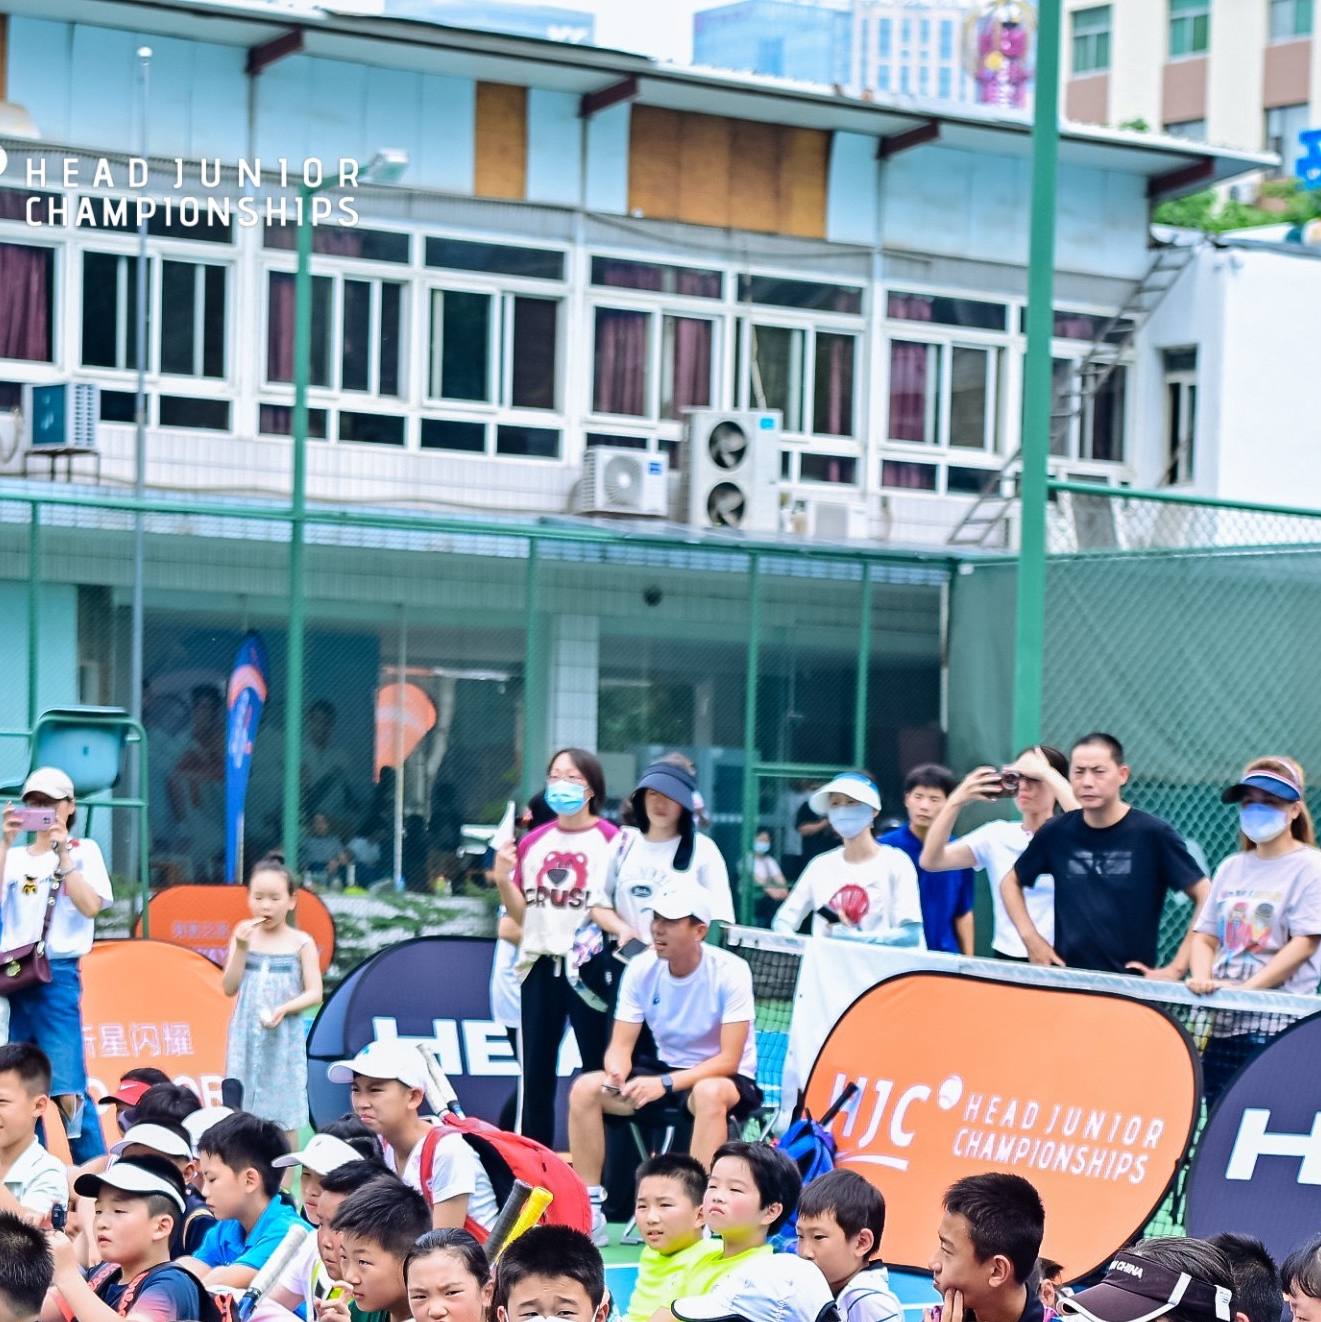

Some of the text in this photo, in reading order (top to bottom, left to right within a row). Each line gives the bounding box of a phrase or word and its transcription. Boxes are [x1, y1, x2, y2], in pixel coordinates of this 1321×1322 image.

[830, 1072, 932, 1151] HJC
[964, 1092, 1166, 1150] HEAD JUNIOR
[952, 1127, 1151, 1185] CHAMPIONSHIPS
[1116, 1262, 1144, 1279] CHINA
